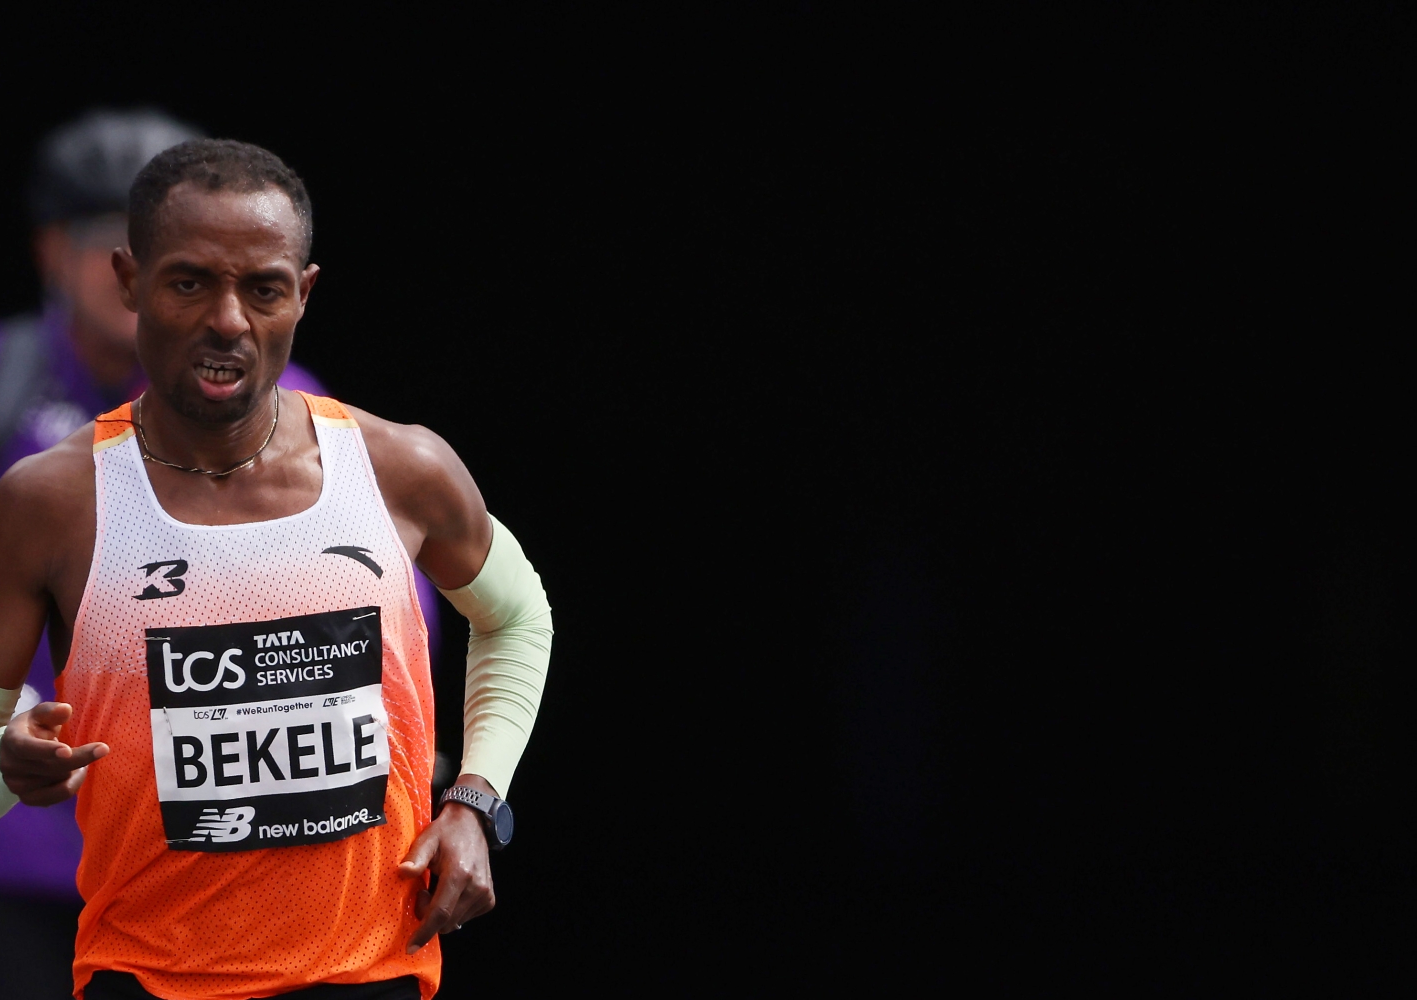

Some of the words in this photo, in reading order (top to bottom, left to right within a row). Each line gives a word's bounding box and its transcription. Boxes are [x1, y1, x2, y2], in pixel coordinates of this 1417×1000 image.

[253, 630, 305, 649] TATA
[254, 639, 370, 668] CONSULTANCY
[162, 642, 246, 693] tcs
[257, 663, 334, 687] SERVICES
[193, 709, 210, 720] tcs
[236, 701, 313, 716] #WeRunTogether
[172, 714, 379, 789] BEKELE
[188, 805, 256, 843] NB
[258, 821, 301, 839] new
[303, 807, 369, 835] balance
